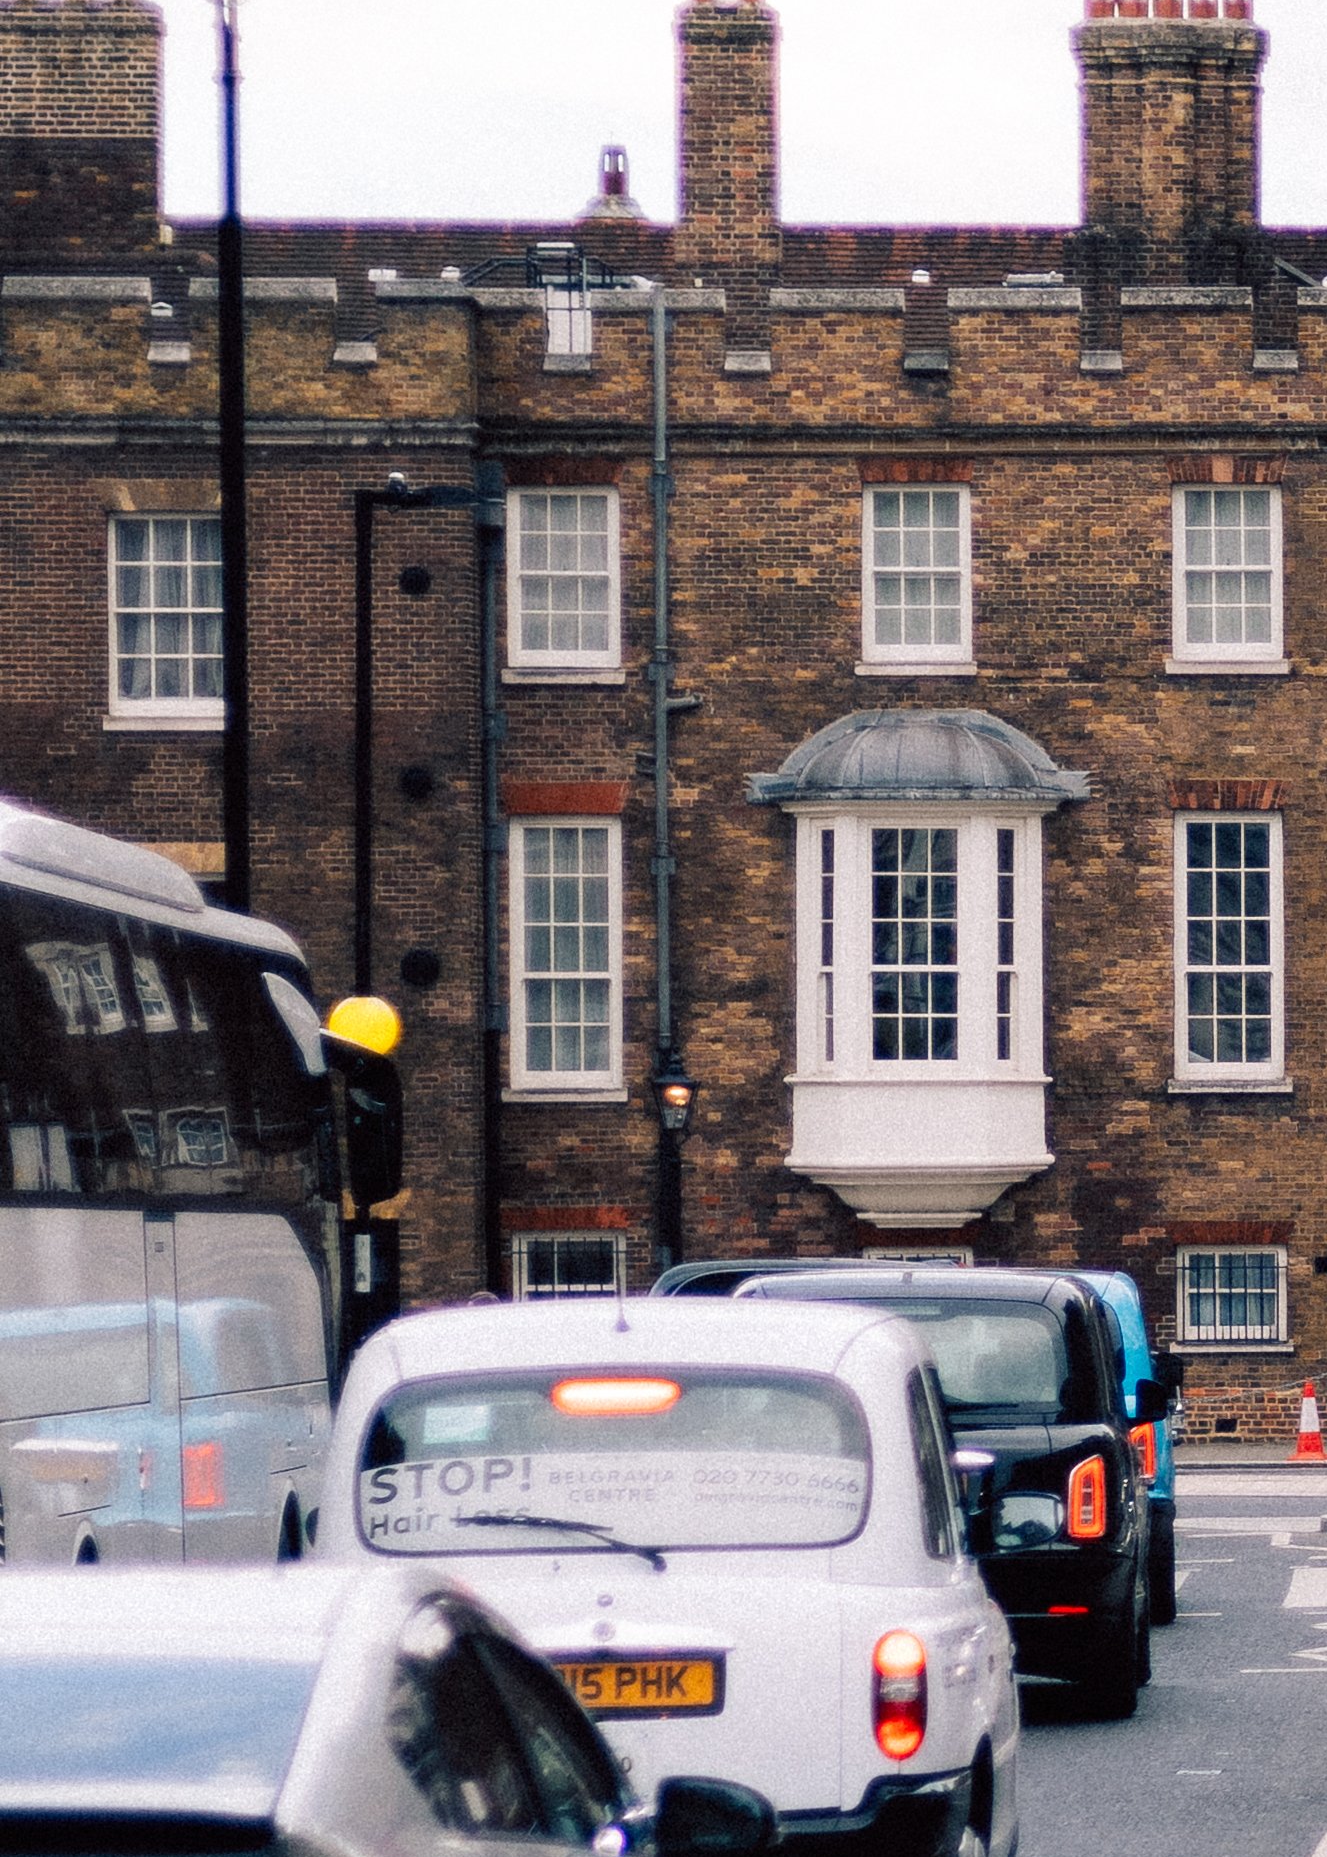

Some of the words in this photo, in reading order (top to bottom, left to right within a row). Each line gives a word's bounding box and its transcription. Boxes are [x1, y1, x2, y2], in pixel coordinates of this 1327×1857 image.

[368, 1456, 532, 1505] STOP!
[549, 1469, 675, 1485] BELGRAVIA
[693, 1469, 738, 1485] 020
[568, 1488, 656, 1503] CENTRE
[369, 1506, 440, 1539] Hair
[614, 1665, 689, 1700] PHK
